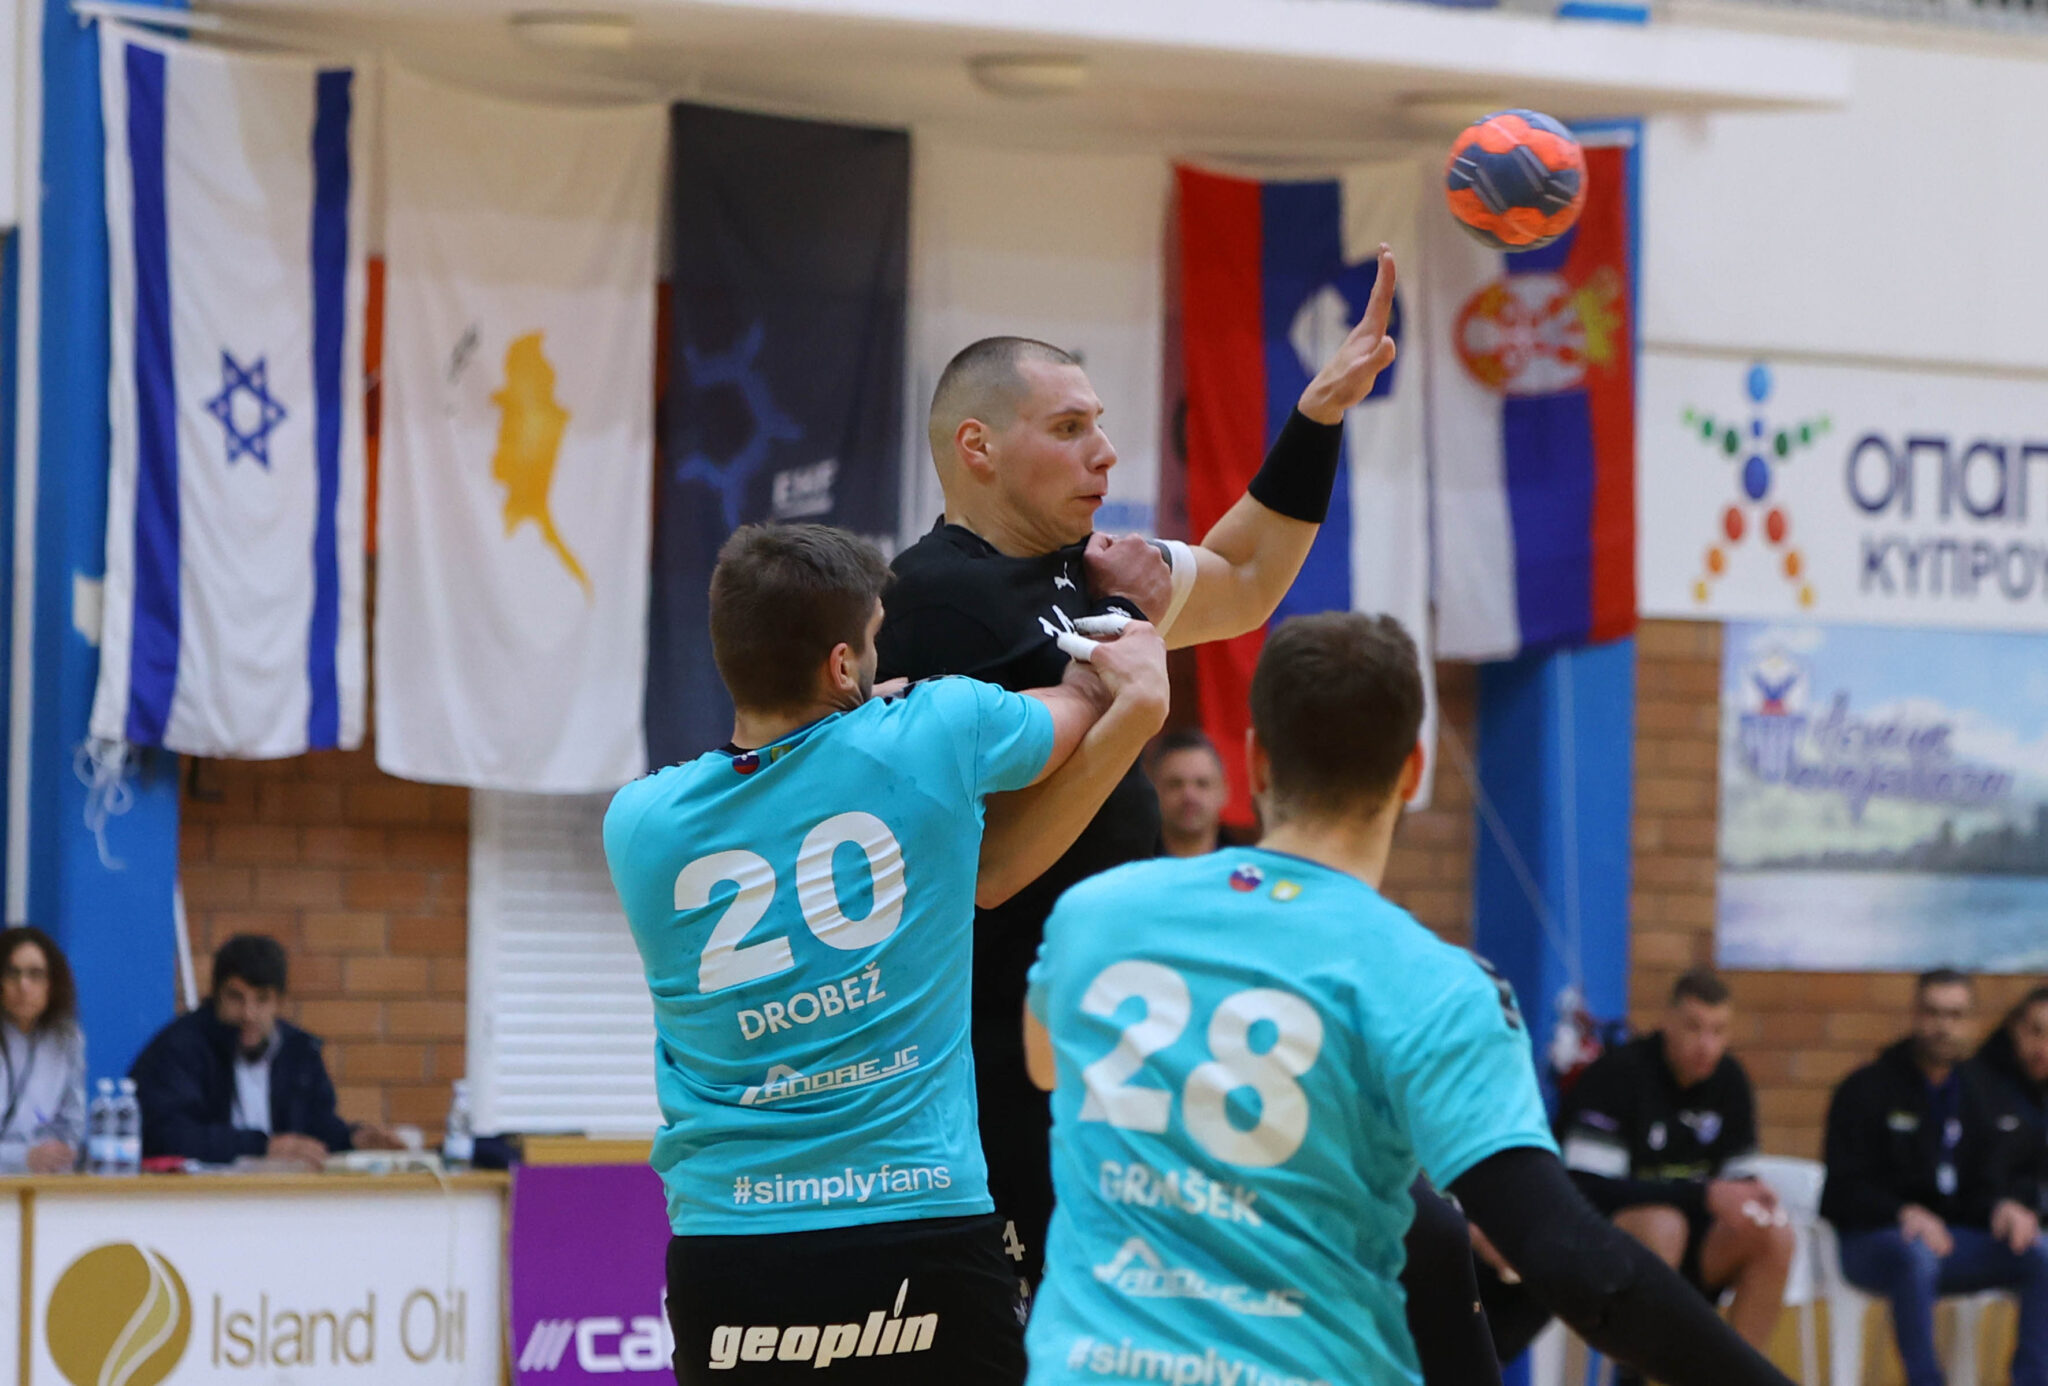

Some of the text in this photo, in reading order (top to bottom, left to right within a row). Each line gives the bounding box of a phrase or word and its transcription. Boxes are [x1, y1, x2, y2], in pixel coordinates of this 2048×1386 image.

[674, 811, 907, 994] 20
[737, 961, 886, 1041] DROBEŽ
[1078, 959, 1324, 1167] 28
[733, 1164, 951, 1206] #simplyfans
[211, 1287, 466, 1367] Island Oil
[709, 1278, 938, 1370] geoplin
